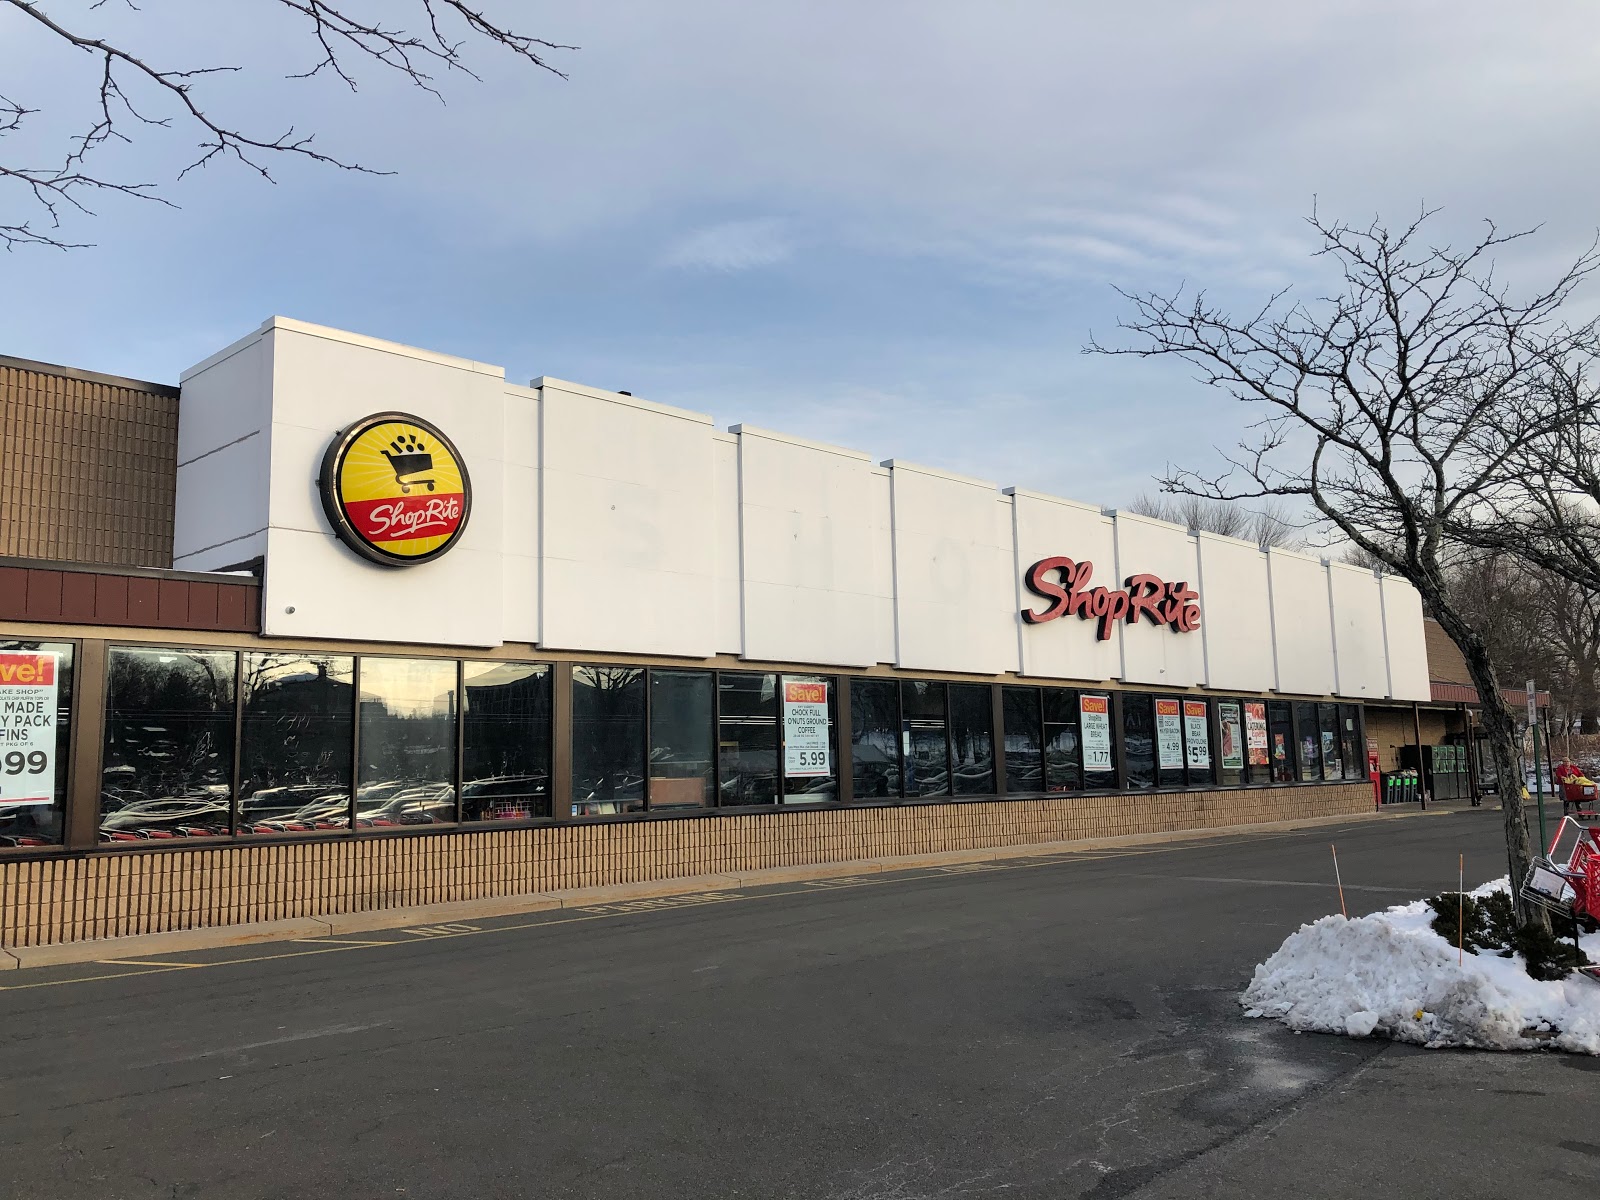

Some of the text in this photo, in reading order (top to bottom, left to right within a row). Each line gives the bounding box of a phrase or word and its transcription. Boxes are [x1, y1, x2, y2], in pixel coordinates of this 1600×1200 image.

[369, 497, 459, 534] ShopRite
[1021, 556, 1200, 640] ShopRite
[789, 685, 823, 701] Save!
[5, 702, 44, 713] MADE
[1084, 699, 1105, 712] Save!
[1158, 703, 1177, 714] Save!
[1186, 704, 1204, 716] Save!
[15, 715, 52, 727] PACK
[1166, 742, 1180, 751] 4.99
[0, 750, 47, 775] 99
[799, 752, 826, 766] 5.99
[1093, 751, 1109, 762] 1.77
[403, 924, 482, 937] NO
[575, 892, 745, 914] PARKING
